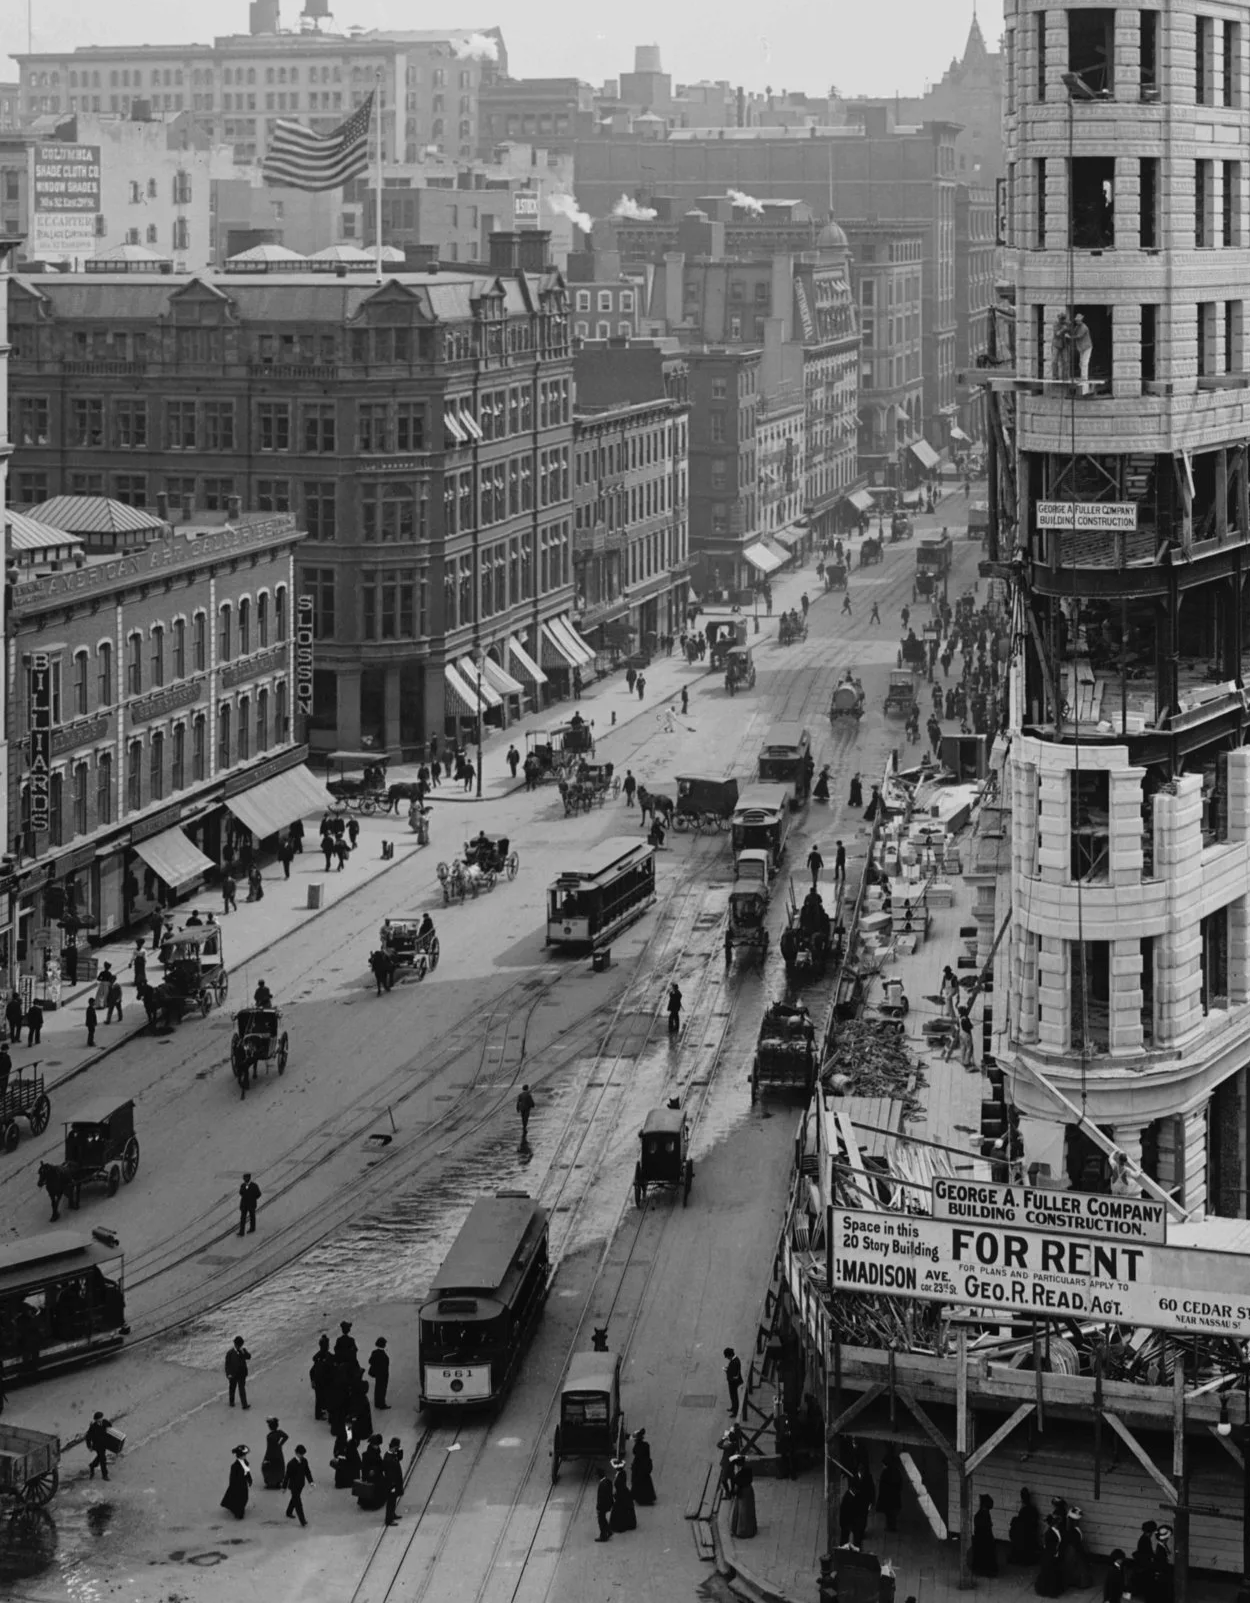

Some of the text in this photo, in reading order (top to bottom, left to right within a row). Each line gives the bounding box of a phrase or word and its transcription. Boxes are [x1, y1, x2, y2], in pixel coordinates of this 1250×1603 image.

[42, 148, 93, 161] COLUMBIA
[36, 165, 62, 178] SHADE
[63, 165, 87, 178] CLOTH
[36, 181, 66, 193] WINDOW
[1038, 504, 1066, 514] GEORGE
[1075, 504, 1101, 515] FULLER
[1102, 505, 1135, 516] COMPANY
[1040, 515, 1075, 525] BUILDING
[50, 555, 140, 594] AMERICAN
[298, 595, 313, 716] SLOSSON
[32, 652, 51, 832] BILLIARDS
[936, 1180, 1163, 1223] GEORGE A. FULLER COMPANY
[843, 1216, 919, 1238] Space in this
[949, 1201, 1147, 1236] BUILDING CONSTRUCTION.
[843, 1234, 940, 1263] 20 Story Building
[952, 1228, 1144, 1282] FOR RENT
[842, 1259, 917, 1290] MADISON
[925, 1270, 951, 1282] AVE.
[959, 1264, 1129, 1292] FOR PLANS AND PARTICULARS APPLY TO
[1159, 1298, 1178, 1312] 60
[1183, 1301, 1232, 1318] CEDAR
[1175, 1314, 1197, 1325] NEAR
[1199, 1317, 1231, 1329] NASSAU
[443, 1369, 473, 1378] 661
